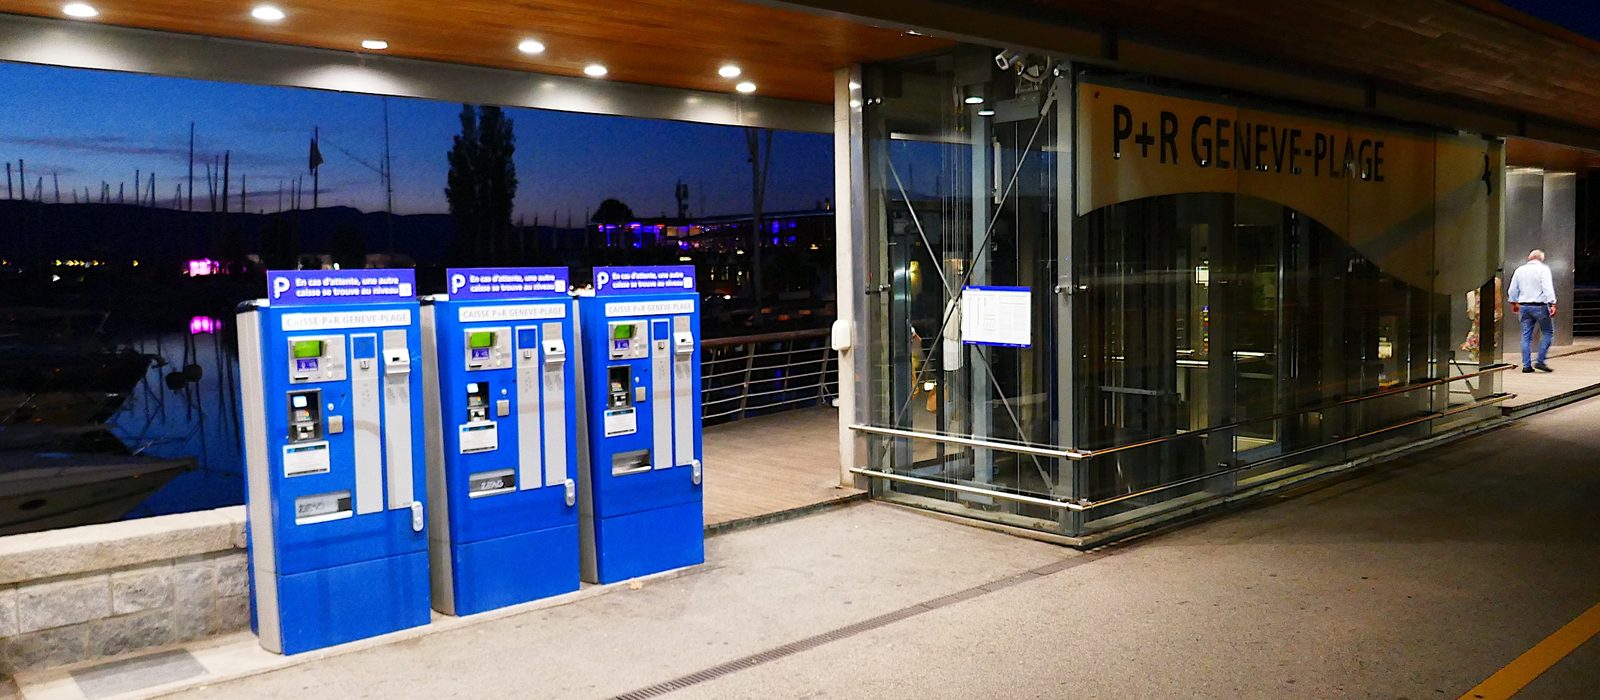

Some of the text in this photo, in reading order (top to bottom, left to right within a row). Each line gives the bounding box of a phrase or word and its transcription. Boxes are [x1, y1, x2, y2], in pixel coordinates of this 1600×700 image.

[1113, 104, 1385, 182] P+R GENEVE-PLAGE
[295, 277, 399, 287] En cas d'attente, une autre
[296, 288, 321, 297] caisse
[322, 288, 332, 296] se
[333, 287, 360, 296] trouve
[373, 286, 399, 295] niveau
[286, 312, 407, 327] CAISSE P+R GENEVE-PLAGE
